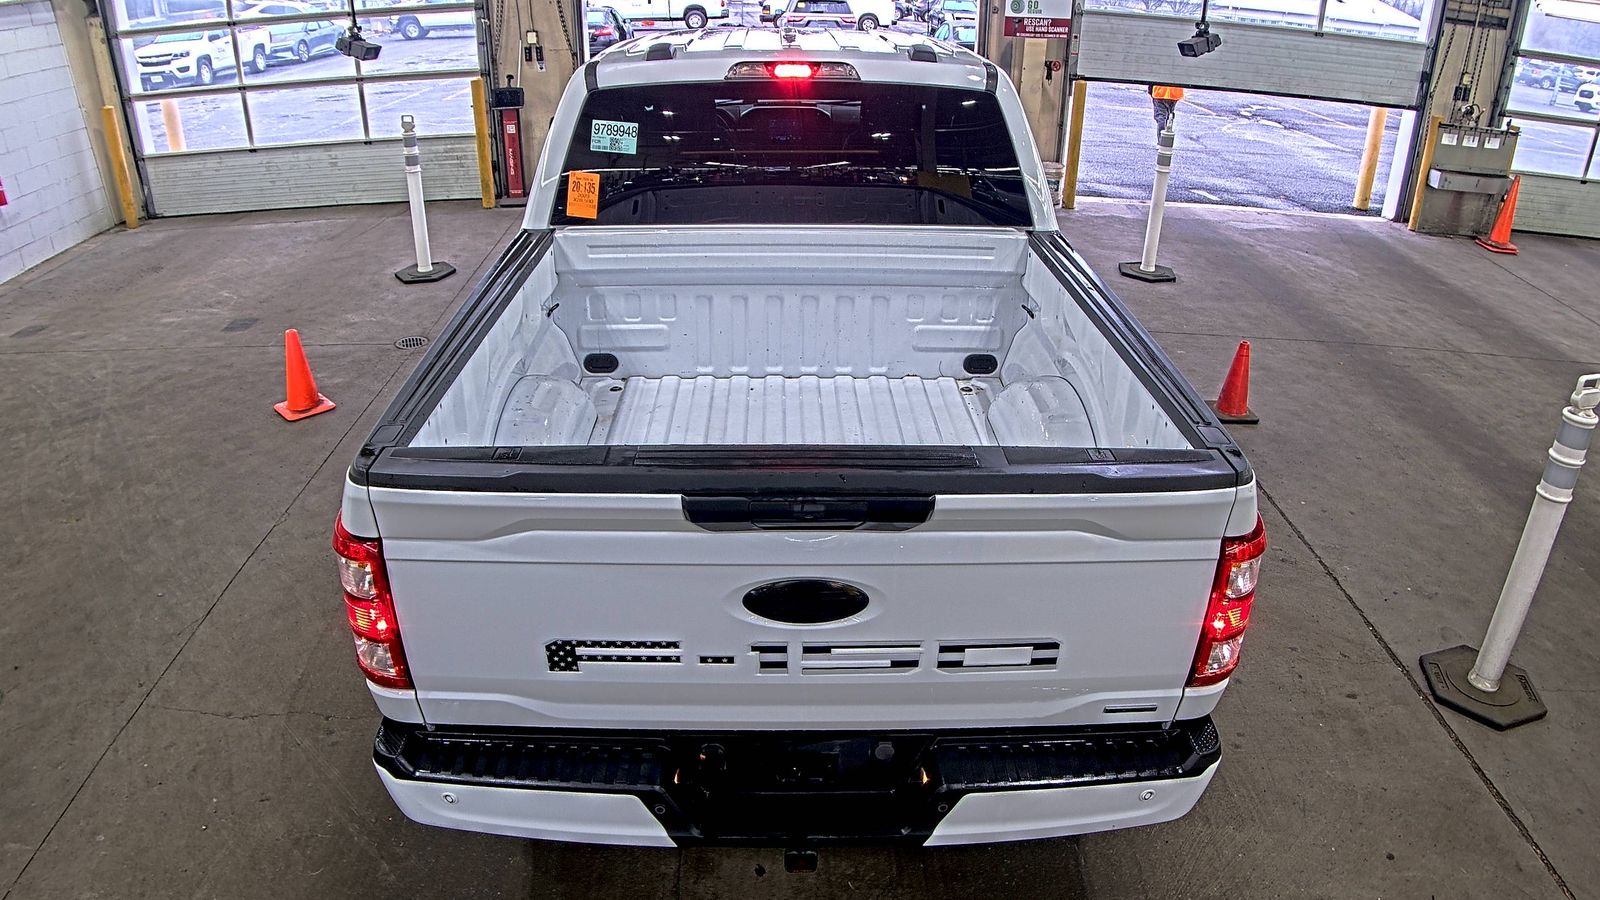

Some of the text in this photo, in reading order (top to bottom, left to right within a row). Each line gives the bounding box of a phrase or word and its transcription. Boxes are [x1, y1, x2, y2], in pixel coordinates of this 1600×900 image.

[1023, 18, 1052, 26] RESCAN?
[593, 122, 638, 138] 9789948
[545, 638, 1062, 675] F-150
